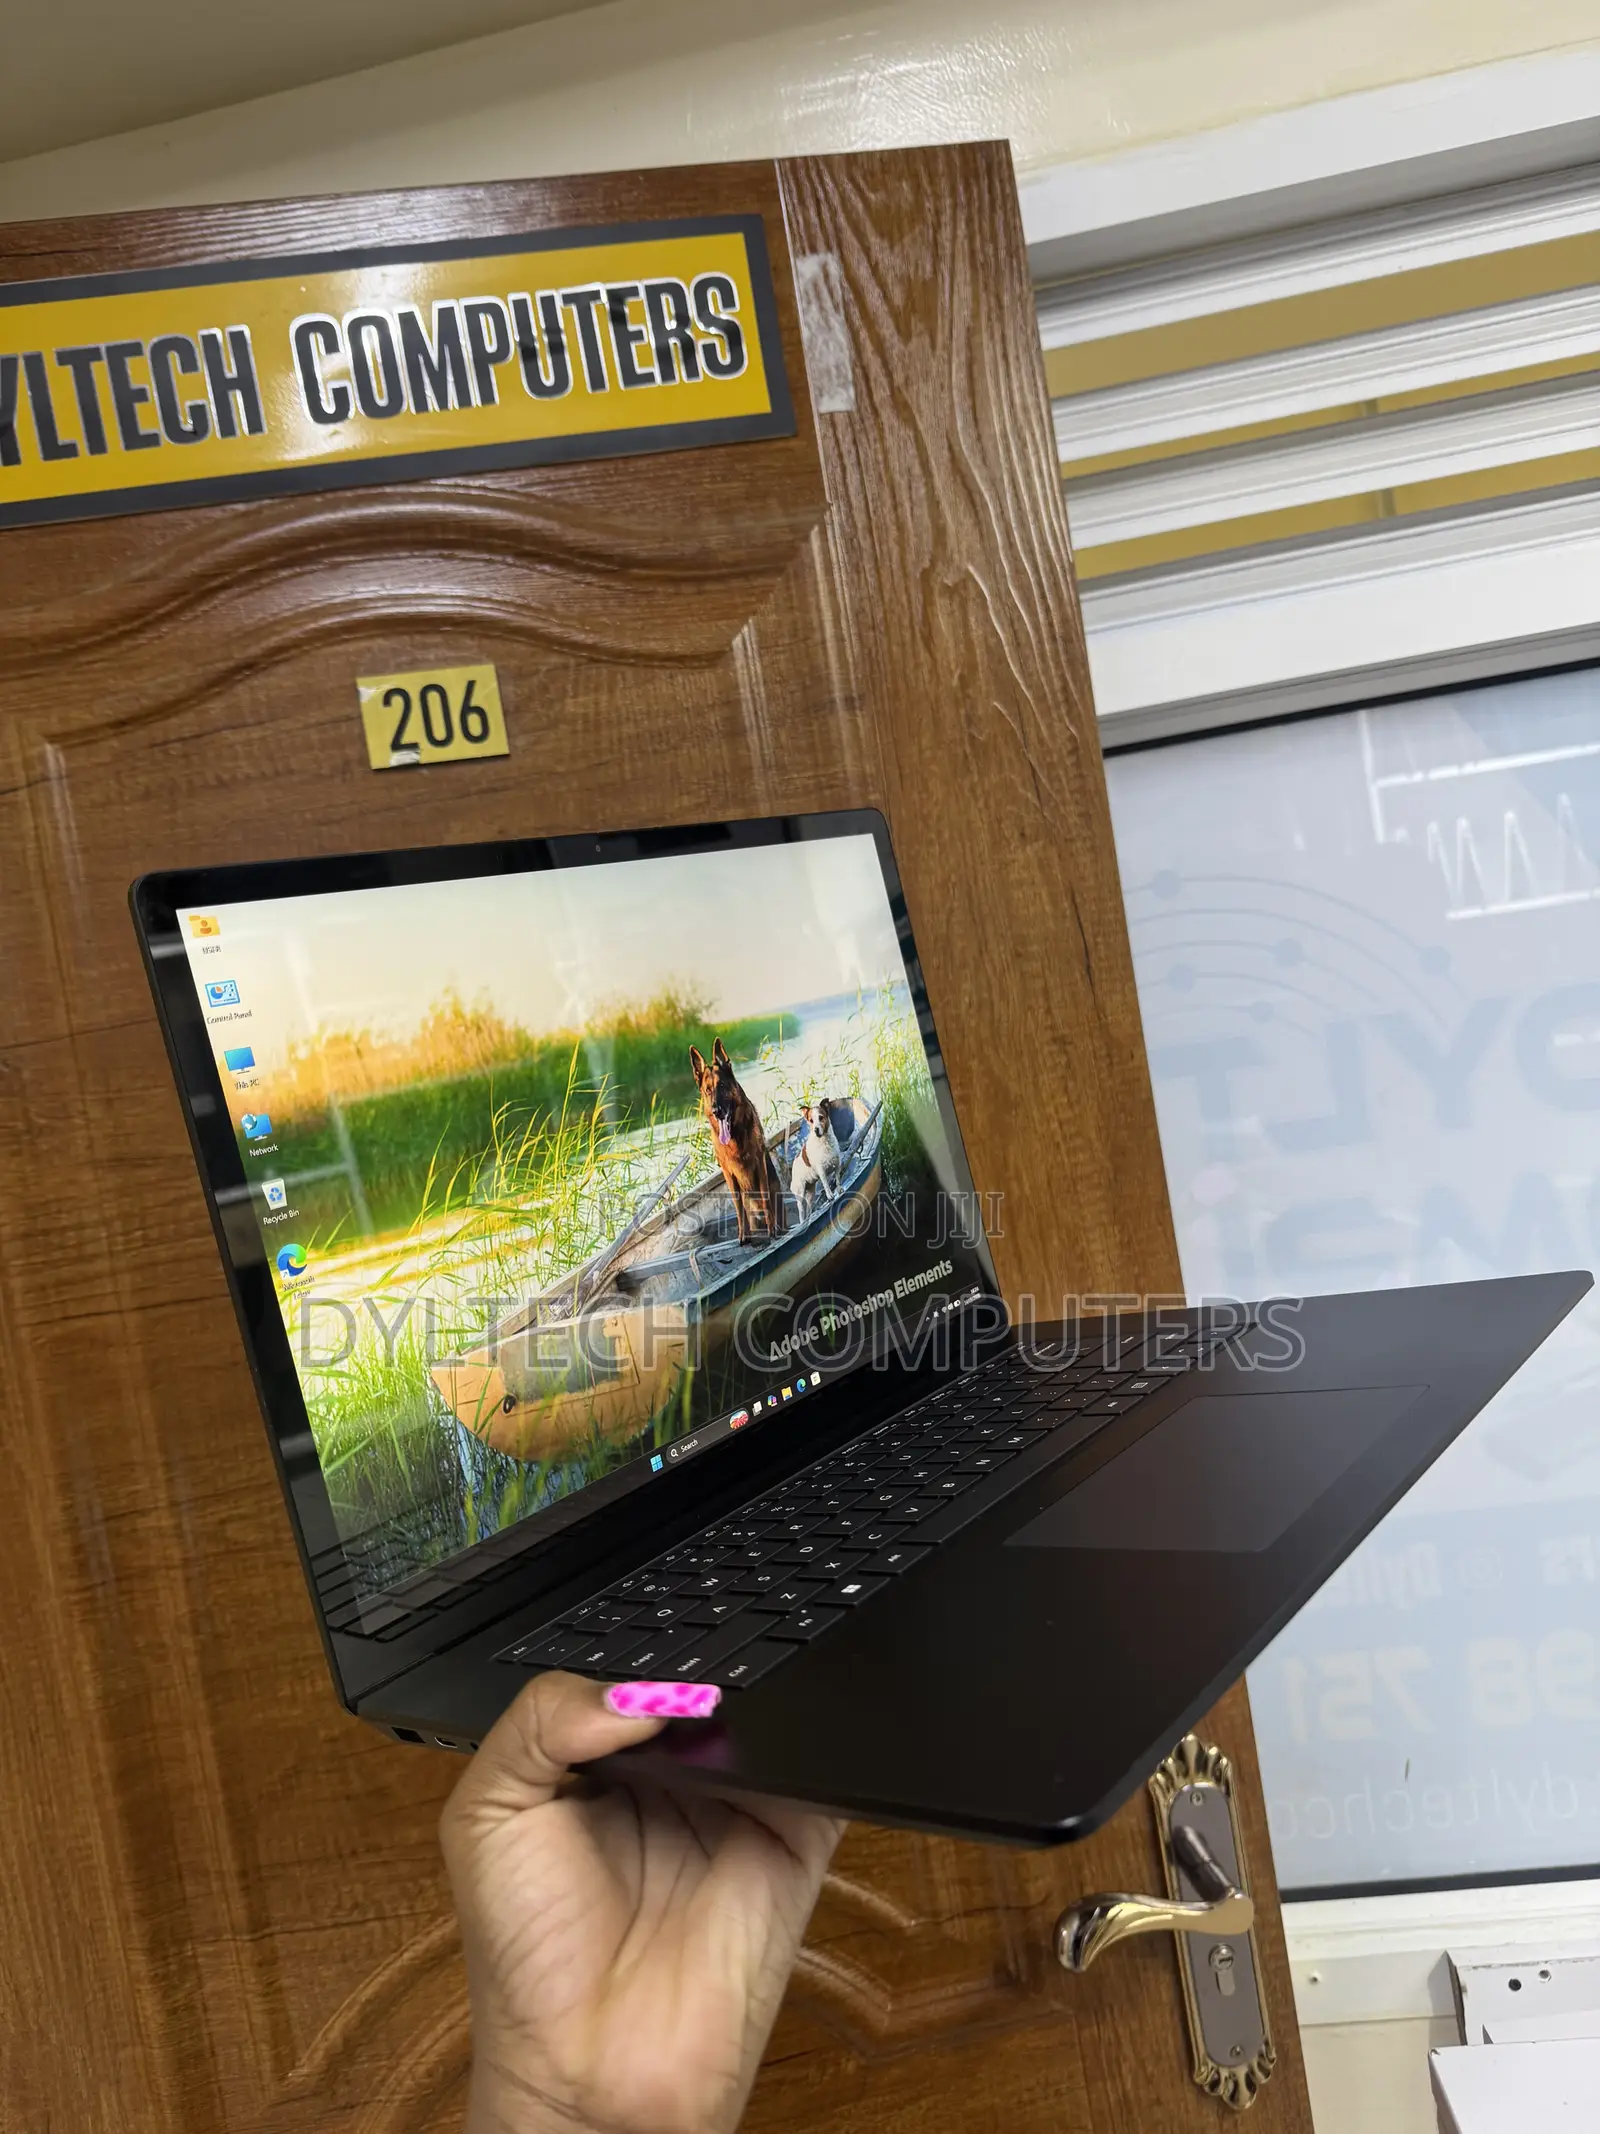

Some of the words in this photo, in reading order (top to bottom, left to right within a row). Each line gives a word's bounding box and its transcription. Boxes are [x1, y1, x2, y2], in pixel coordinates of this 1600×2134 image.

[290, 272, 749, 426] COMPUTERS
[381, 680, 491, 752] 206
[249, 1143, 279, 1157] Network
[263, 1212, 288, 1225] Recycle
[288, 1209, 300, 1219] Bin
[769, 1327, 820, 1362] Adobe
[819, 1288, 894, 1336] Photoshop
[894, 1258, 953, 1299] Elements
[680, 1439, 699, 1453] Search
[631, 1652, 655, 1667] Caps
[677, 1657, 702, 1672] Shift
